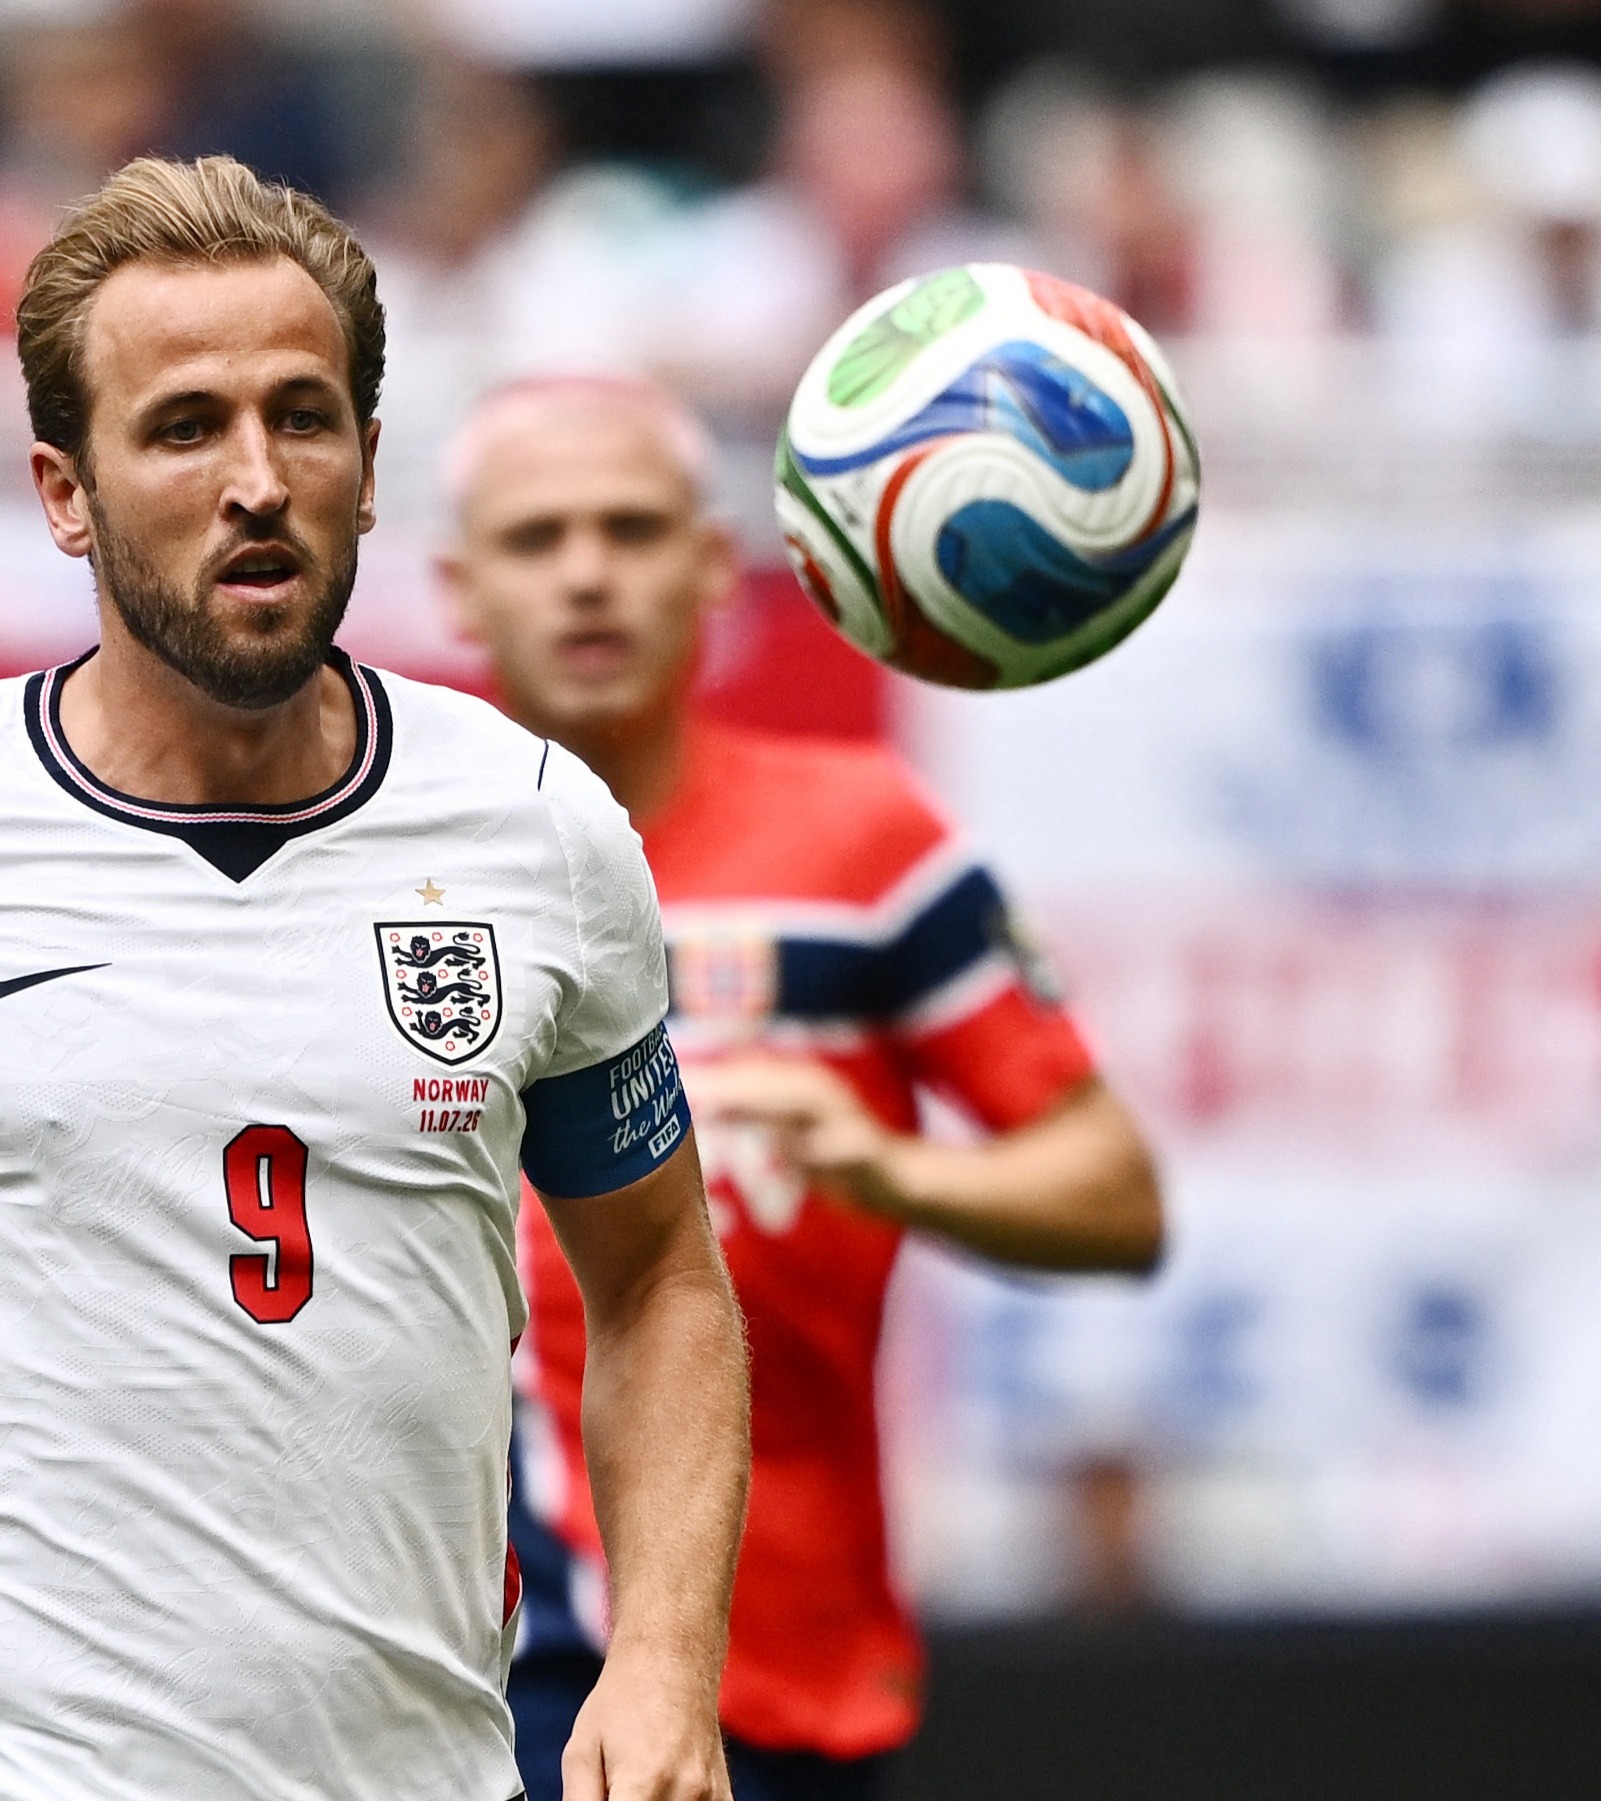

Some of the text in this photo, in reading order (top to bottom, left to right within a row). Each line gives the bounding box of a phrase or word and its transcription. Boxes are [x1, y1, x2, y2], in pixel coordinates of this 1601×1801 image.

[609, 1024, 663, 1089] FOOTBA
[412, 1078, 489, 1102] NORWAY
[611, 1032, 675, 1120] UNITES
[419, 1109, 481, 1133] 11.07.26
[607, 1118, 651, 1154] the
[650, 1120, 680, 1155] FIFA
[222, 1123, 315, 1325] 9
